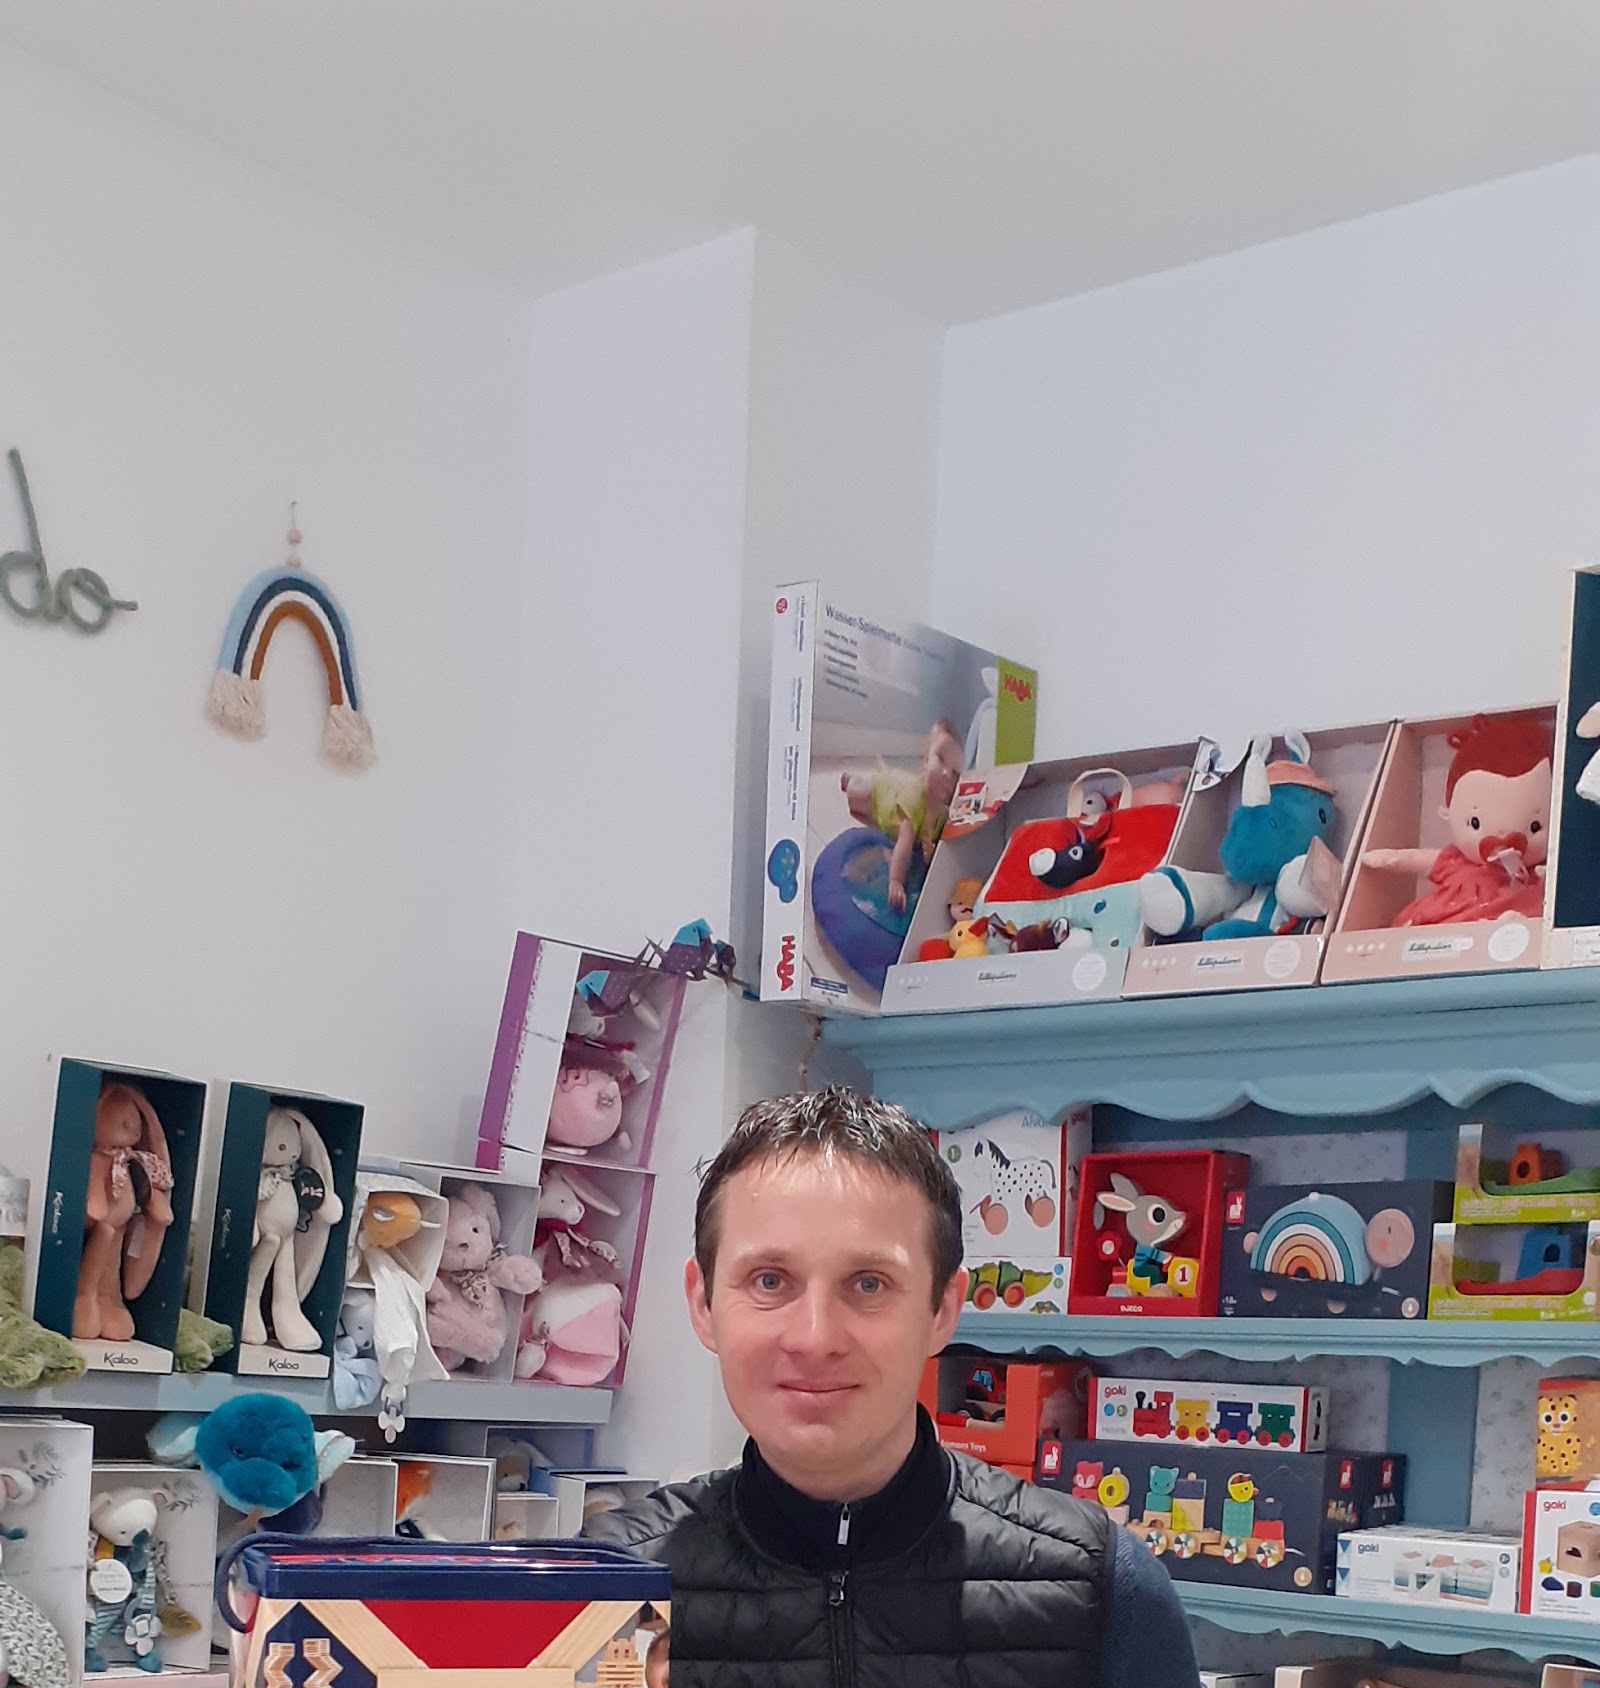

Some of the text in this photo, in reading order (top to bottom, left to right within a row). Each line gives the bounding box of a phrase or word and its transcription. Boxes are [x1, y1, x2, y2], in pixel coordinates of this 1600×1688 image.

[1004, 674, 1031, 702] HABA
[777, 935, 796, 992] HABA
[1179, 1266, 1188, 1282] 1
[103, 1353, 139, 1368] Kaloo
[268, 1357, 300, 1373] Kaloo
[1104, 1385, 1127, 1398] goki
[970, 1442, 987, 1452] Toys
[1542, 1501, 1566, 1511] goki
[1357, 1543, 1379, 1554] goki
